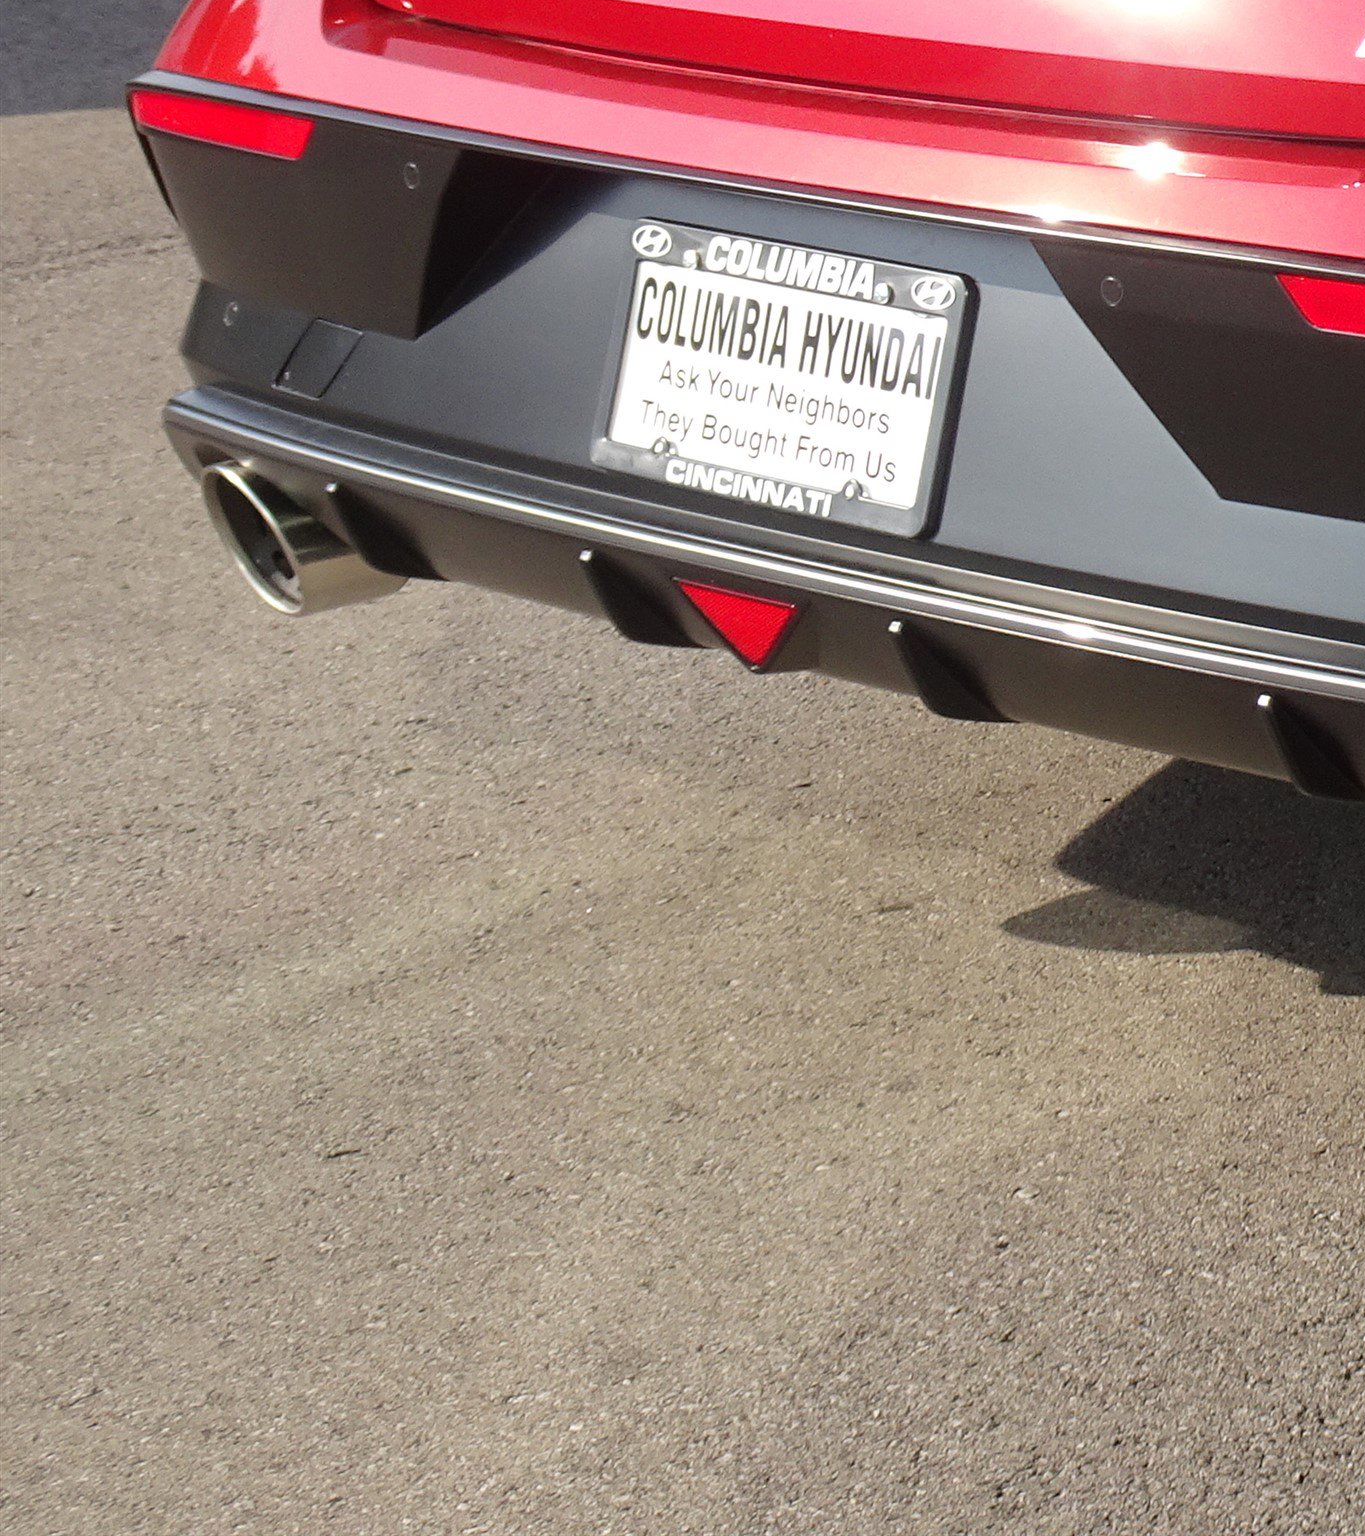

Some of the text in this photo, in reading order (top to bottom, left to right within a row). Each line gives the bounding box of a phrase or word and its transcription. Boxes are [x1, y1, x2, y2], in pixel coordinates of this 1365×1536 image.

[705, 236, 877, 301] COLUMBIA
[636, 277, 942, 400] COLUMBIA HYUNDAI
[658, 360, 890, 434] Ask Your Neighbors
[641, 399, 897, 483] They Bought From Us
[664, 458, 833, 518] CINCINNATI
